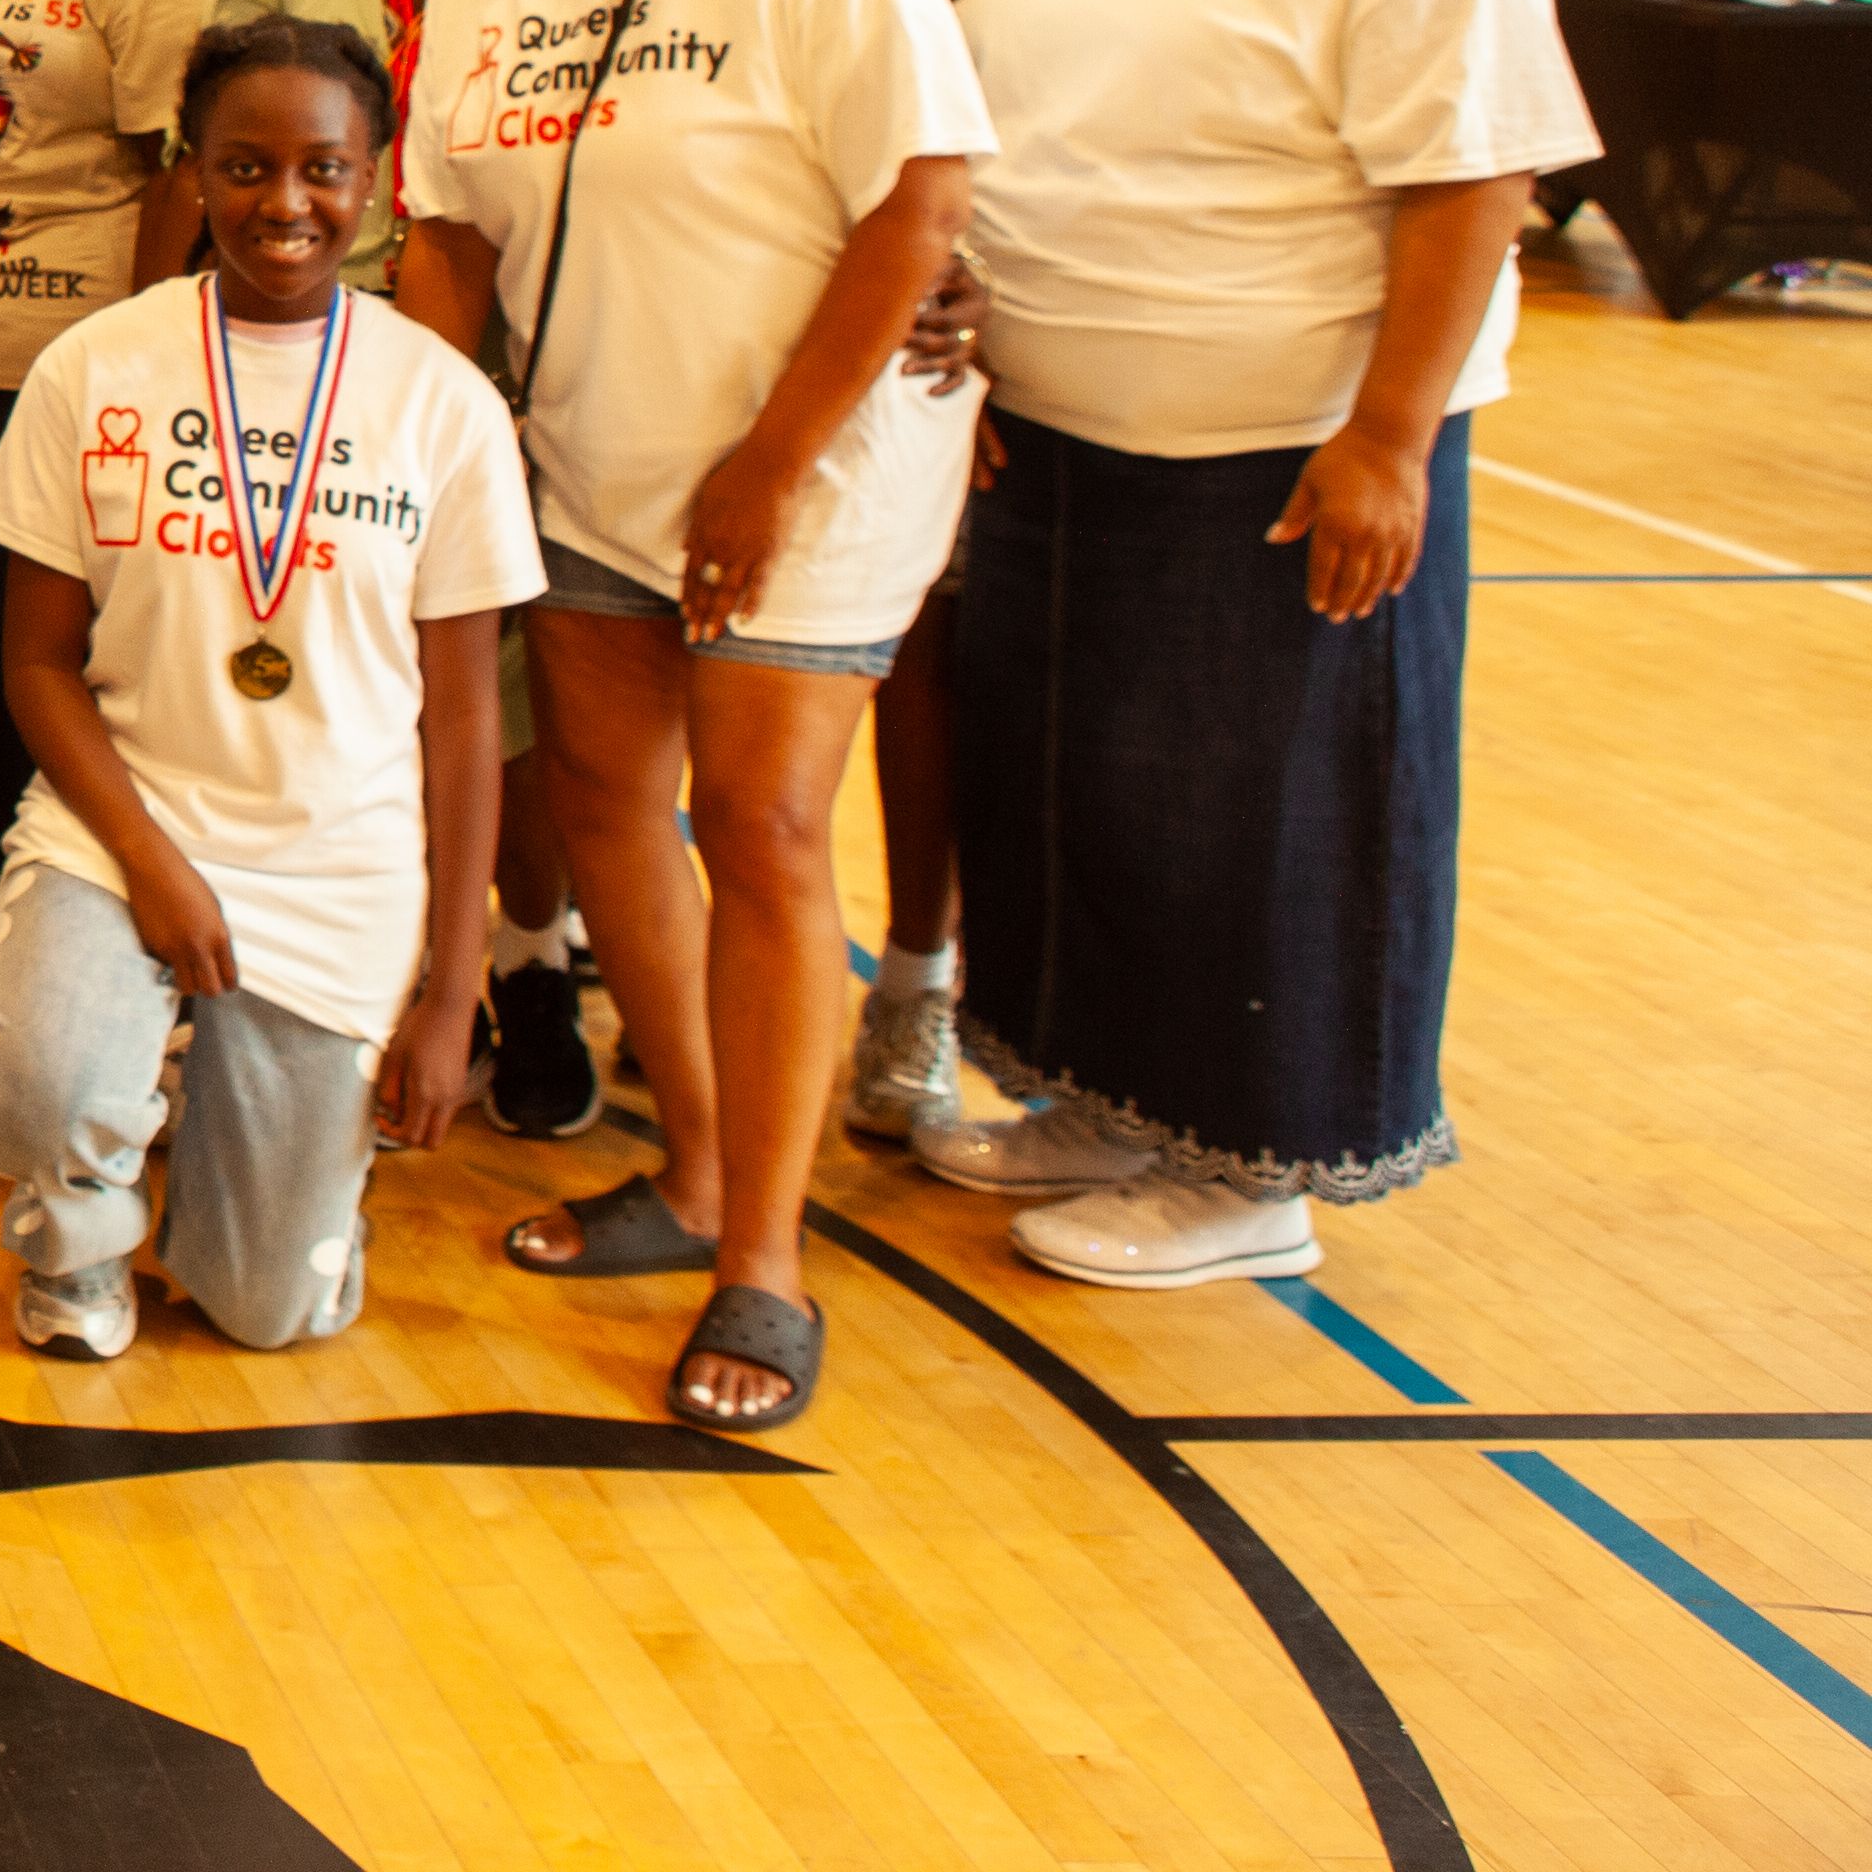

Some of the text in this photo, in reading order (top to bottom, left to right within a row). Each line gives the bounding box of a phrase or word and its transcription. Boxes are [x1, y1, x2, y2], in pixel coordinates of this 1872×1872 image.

[3, 1, 36, 22] IS
[44, 0, 85, 30] 55
[506, 28, 732, 98] Comunity
[171, 408, 353, 466] Qees
